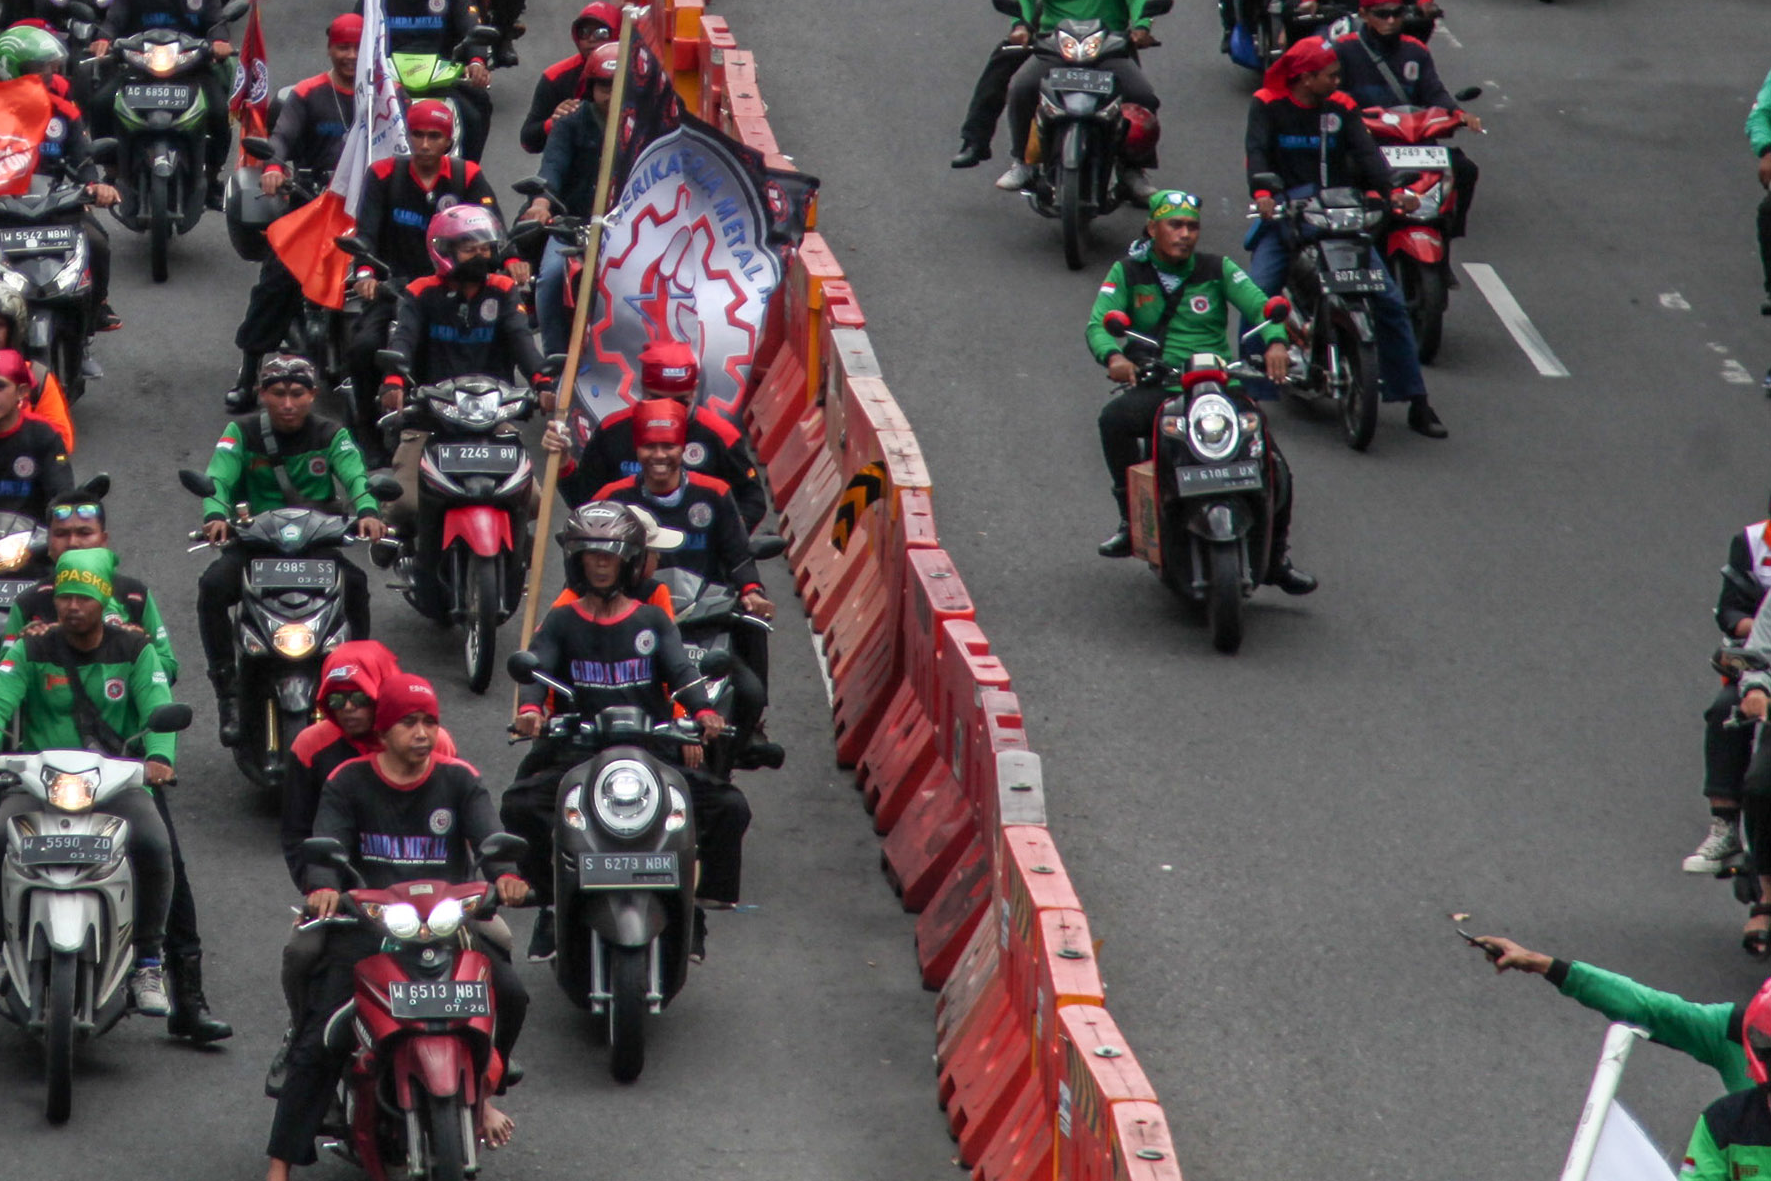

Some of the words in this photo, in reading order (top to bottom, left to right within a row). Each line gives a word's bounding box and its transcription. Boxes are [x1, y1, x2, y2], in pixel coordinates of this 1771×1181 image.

[146, 88, 169, 97] 6850
[16, 232, 42, 240] 5542
[48, 230, 68, 239] NBM
[714, 197, 764, 282] METAL
[1335, 271, 1361, 281] 6074
[1369, 270, 1383, 280] WE
[460, 448, 489, 458] 2245
[275, 563, 306, 572] 4985
[318, 563, 332, 572] SS
[571, 659, 613, 684] GARDA
[614, 658, 652, 683] METAL
[46, 838, 80, 849] 5590
[94, 838, 110, 849] ZD
[360, 833, 400, 859] GARDA
[403, 835, 447, 859] METAL
[605, 858, 639, 869] 6279
[645, 858, 671, 869] NBK
[410, 985, 447, 998] 6513
[456, 985, 482, 998] NBT
